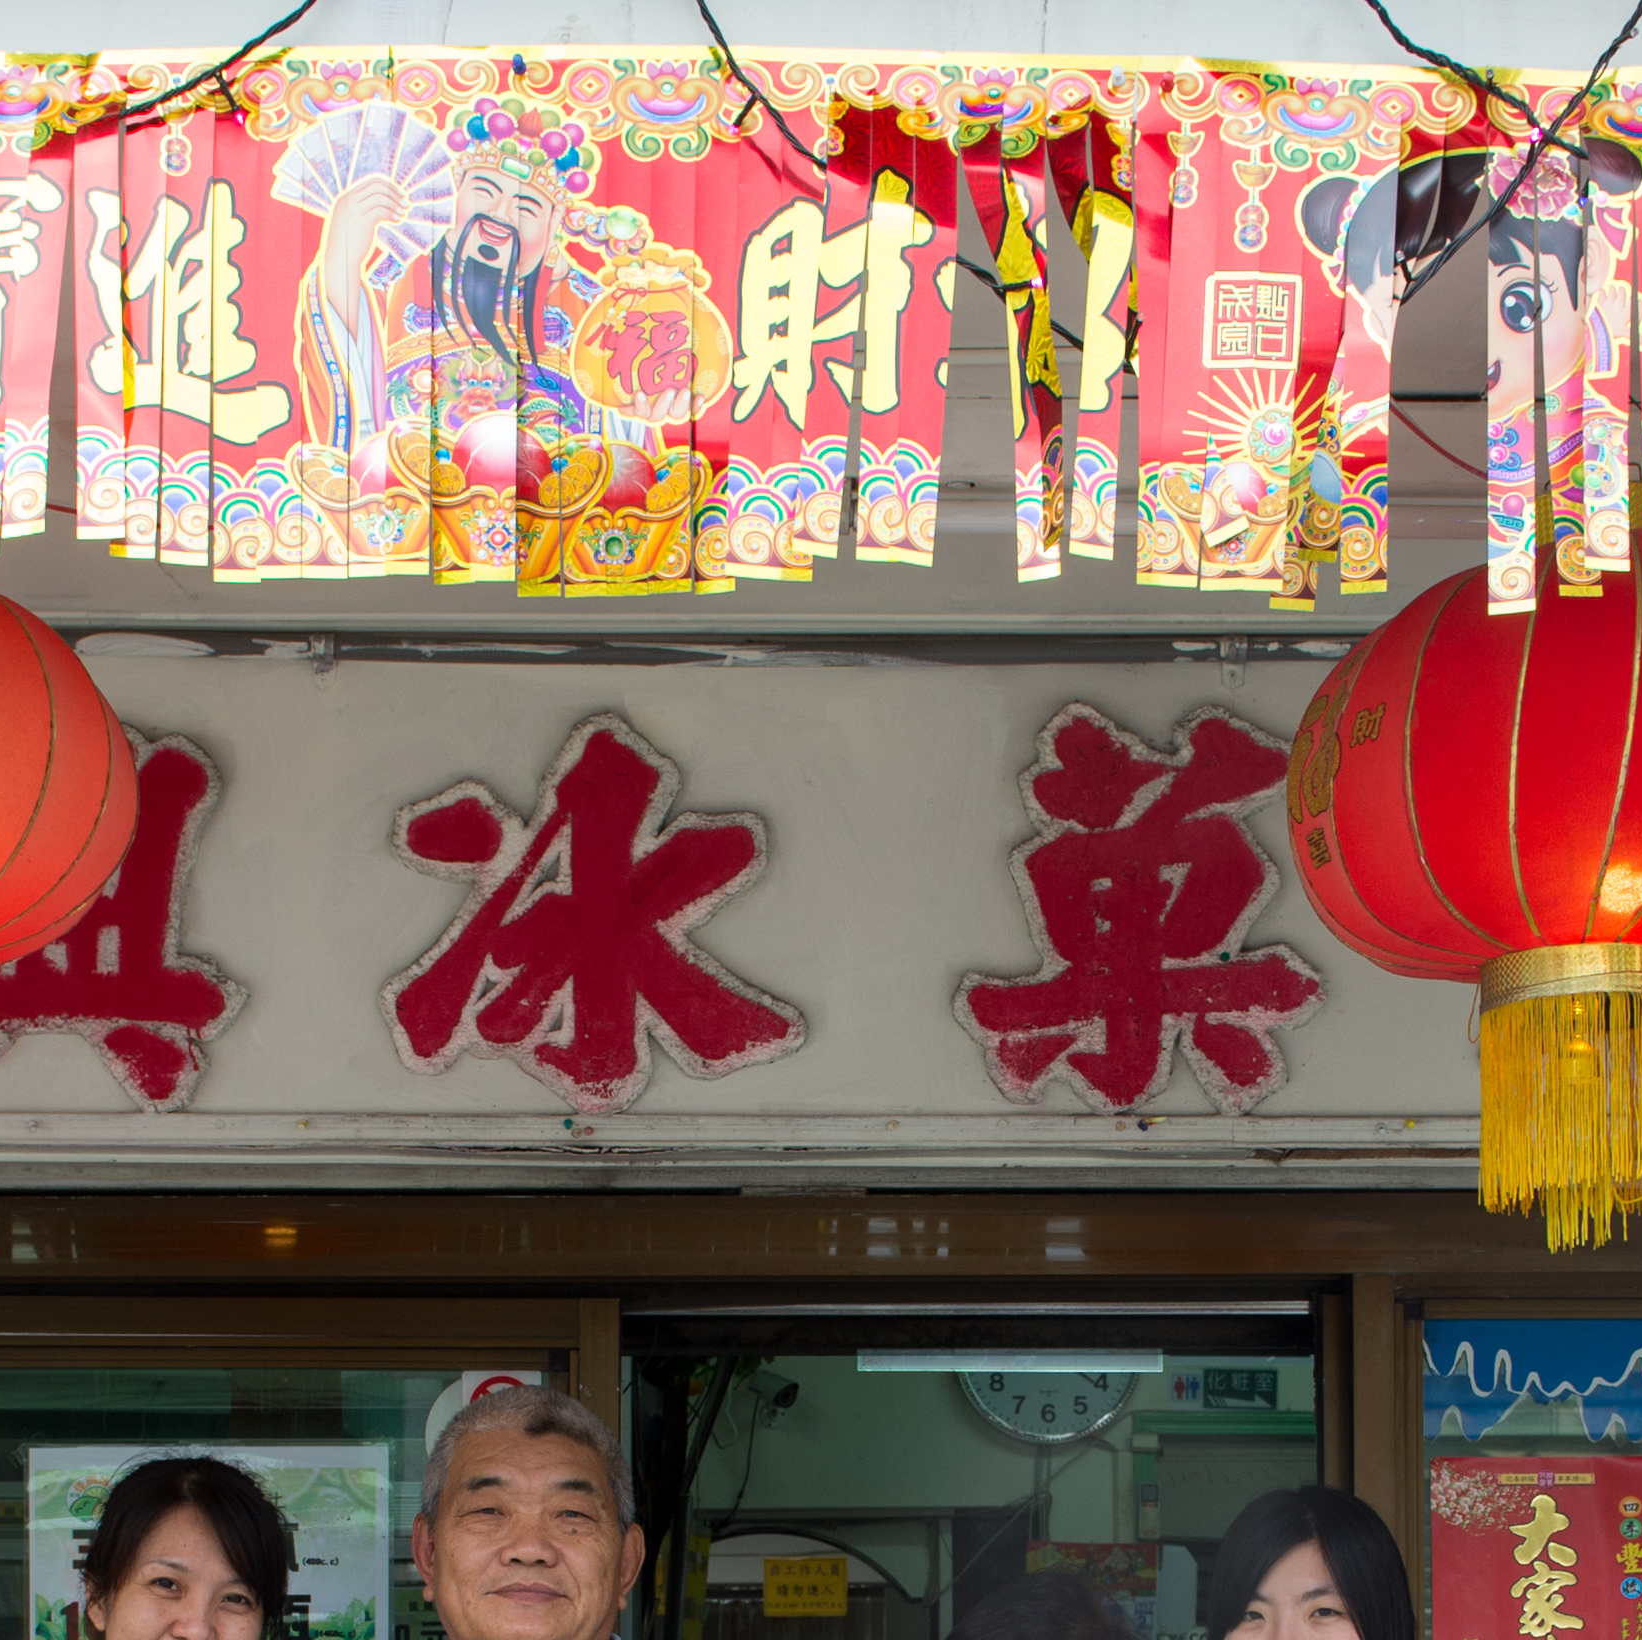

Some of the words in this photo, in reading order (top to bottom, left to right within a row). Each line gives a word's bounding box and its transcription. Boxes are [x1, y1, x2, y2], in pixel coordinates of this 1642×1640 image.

[605, 309, 694, 395] 福
[989, 1372, 1005, 1391] 8
[1093, 1373, 1110, 1390] 4
[1207, 1370, 1276, 1391] 化粧室
[1012, 1395, 1027, 1414] 7
[1040, 1404, 1057, 1424] 6
[1073, 1396, 1088, 1415] 5
